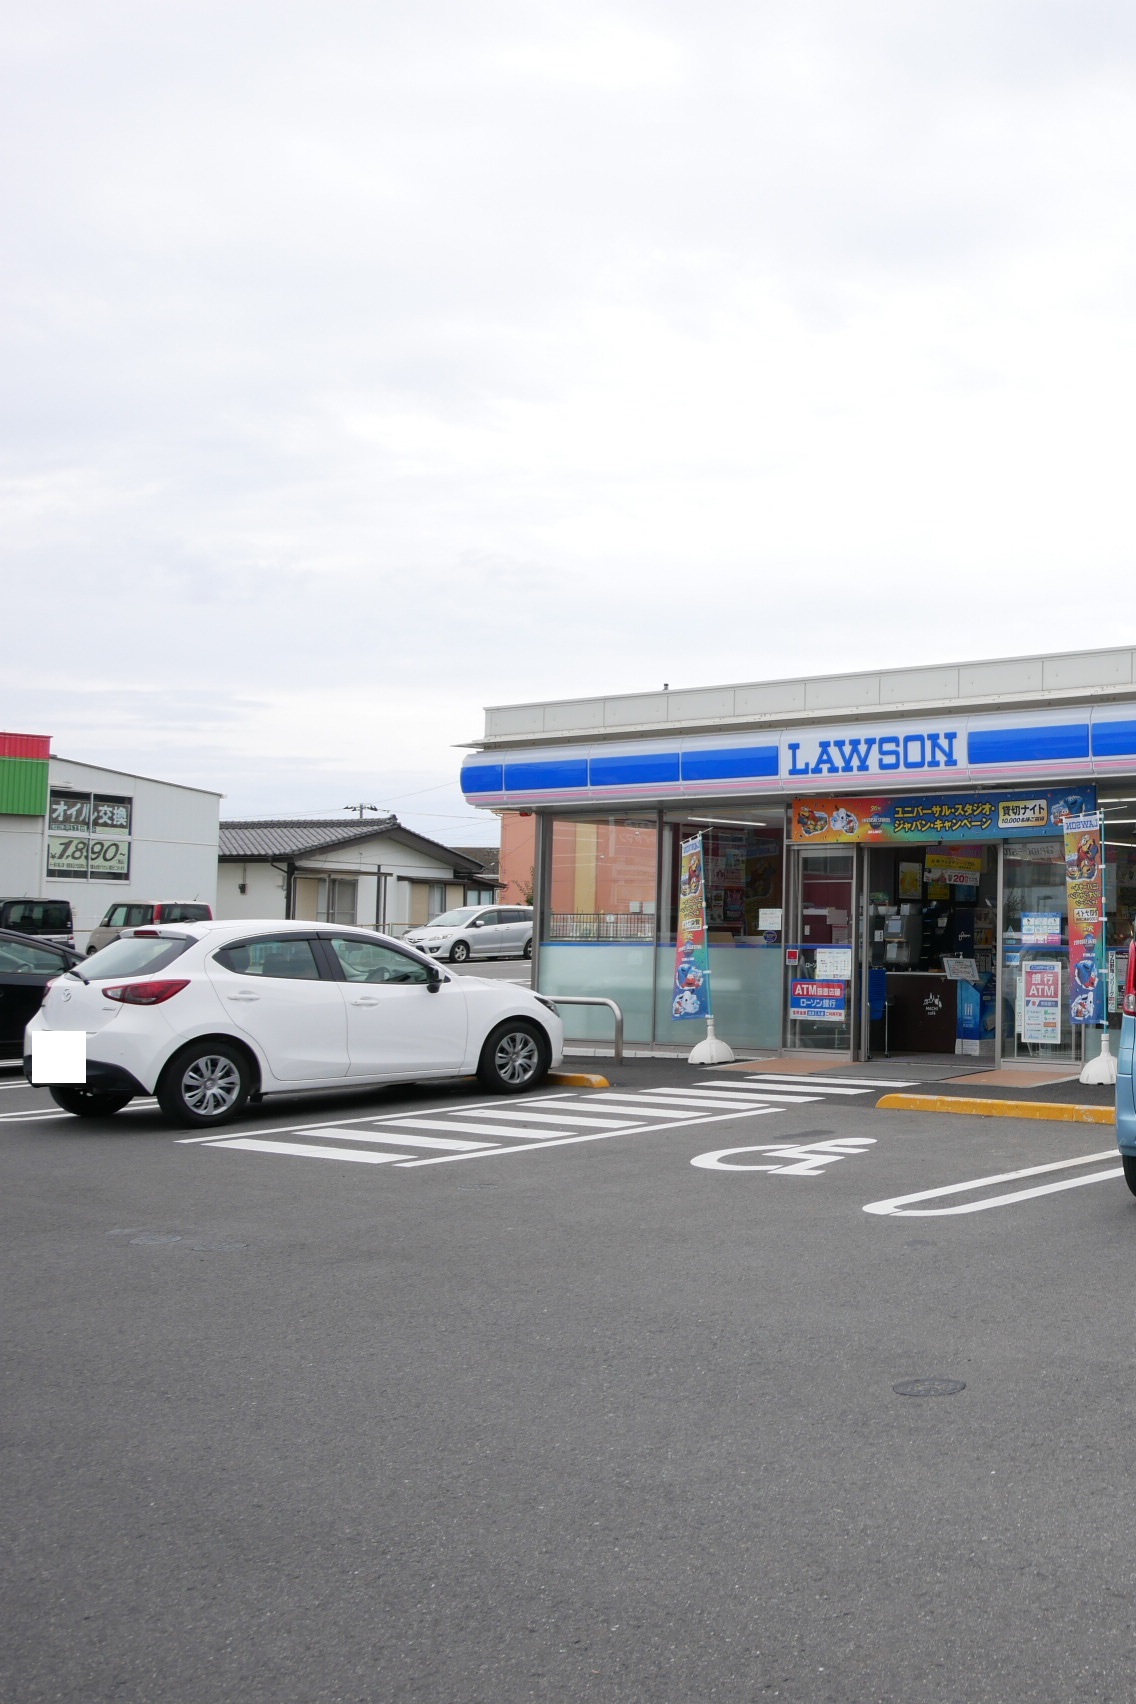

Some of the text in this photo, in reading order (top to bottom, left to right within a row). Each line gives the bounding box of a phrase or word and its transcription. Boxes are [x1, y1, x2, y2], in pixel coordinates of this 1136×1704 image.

[788, 731, 958, 776] LAWSON
[52, 801, 127, 825] オイル交換
[1002, 803, 1045, 817] 貸切ナイト
[894, 817, 992, 833] ジャパン・キャンペーン
[1031, 973, 1054, 984] 銀行
[1029, 985, 1054, 996] ATM
[800, 998, 836, 1008] ローソン銀行
